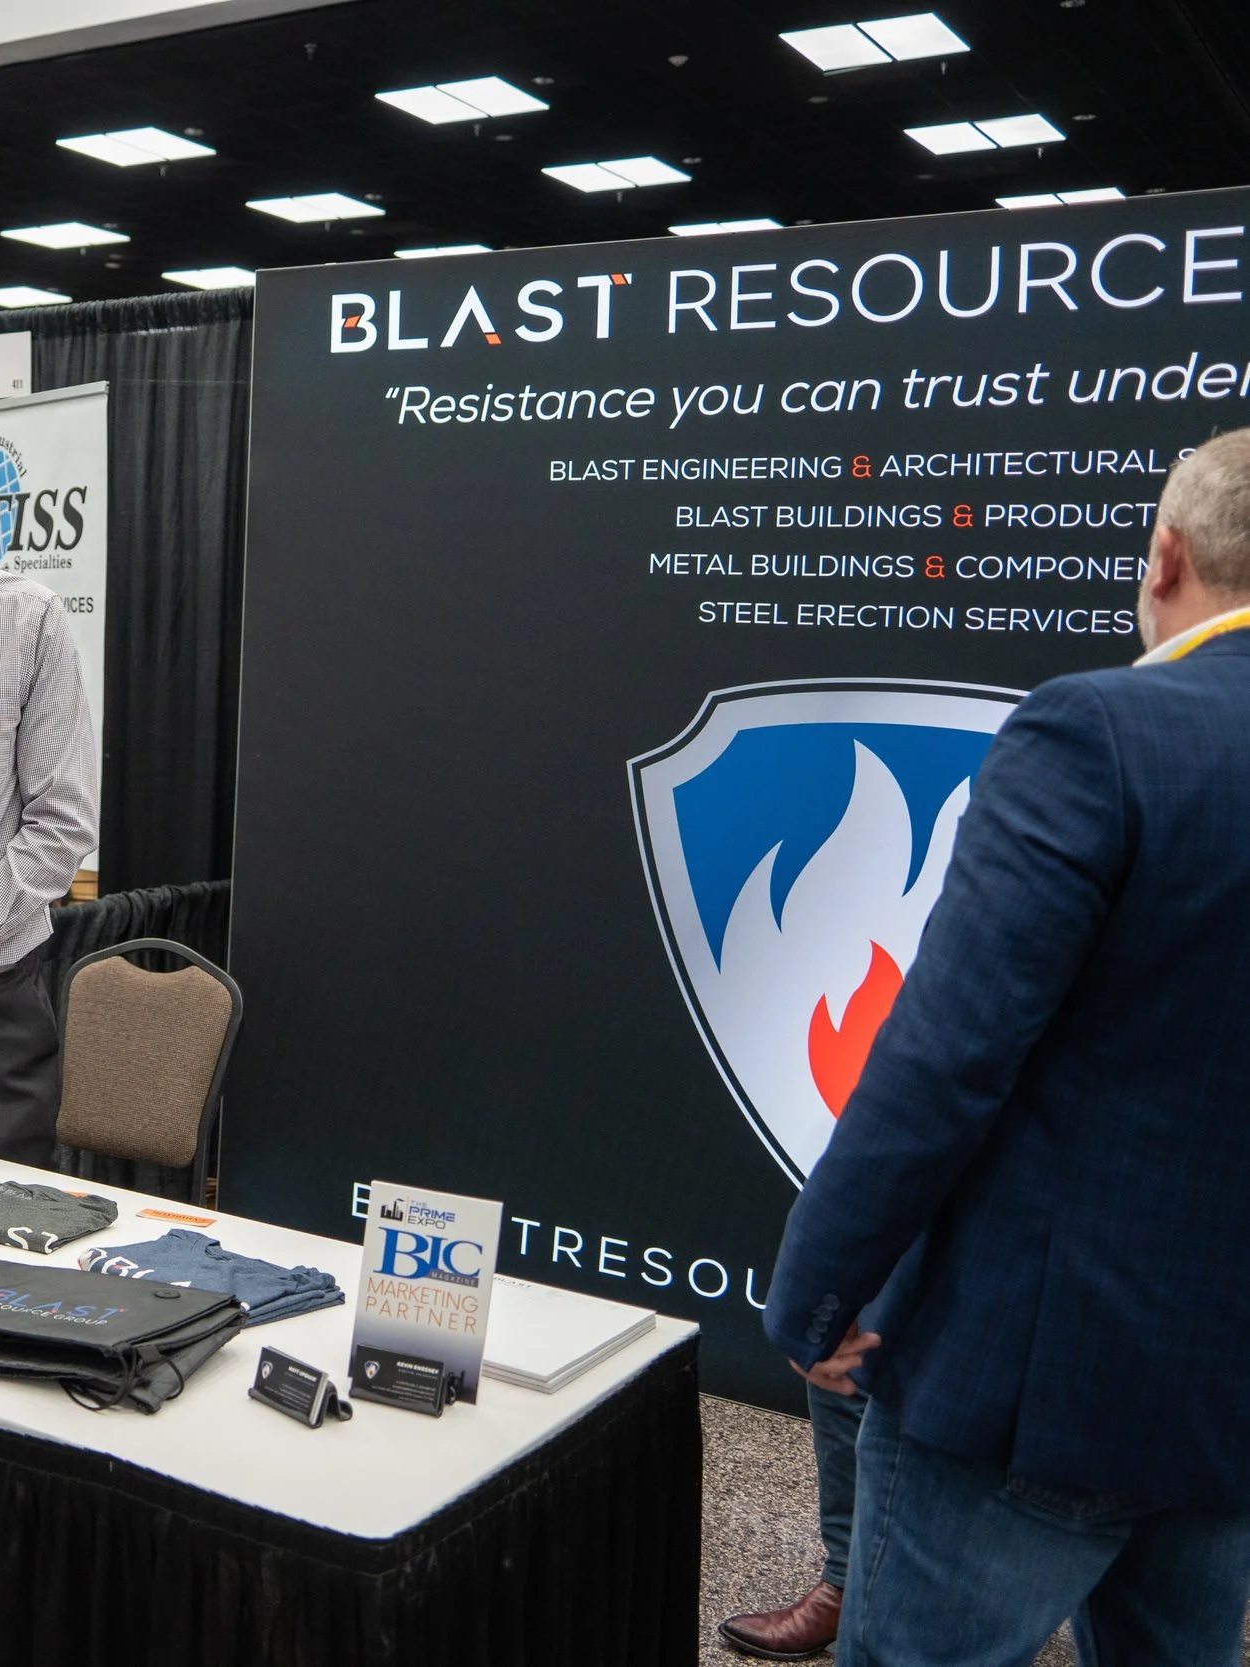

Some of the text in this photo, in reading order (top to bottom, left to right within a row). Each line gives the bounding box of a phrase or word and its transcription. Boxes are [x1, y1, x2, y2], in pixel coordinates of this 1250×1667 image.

[330, 226, 1245, 353] BLAST RESOURCE
[668, 384, 764, 430] you
[781, 378, 881, 413] can
[903, 363, 1049, 409] trust
[550, 459, 635, 481] BLAST
[643, 456, 842, 480] ENGINEERING
[852, 455, 871, 478] &
[880, 449, 1167, 477] ARCHITECTURAL
[676, 503, 1157, 528] BLAST BUILDINGS & PRODUCT
[13, 553, 73, 573] Specialties
[650, 553, 1151, 580] METAL BUILDINGS & COMPONEN
[699, 601, 1134, 633] STEEL ERECTION SERVICES
[408, 1215, 446, 1229] EXPO
[409, 1206, 456, 1222] PRIME
[372, 1226, 483, 1280] BIC
[431, 1272, 476, 1286] MAGAZINE
[367, 1277, 478, 1314] MARKETING
[53, 1313, 107, 1326] GROUP
[365, 1296, 477, 1334] PARTNER
